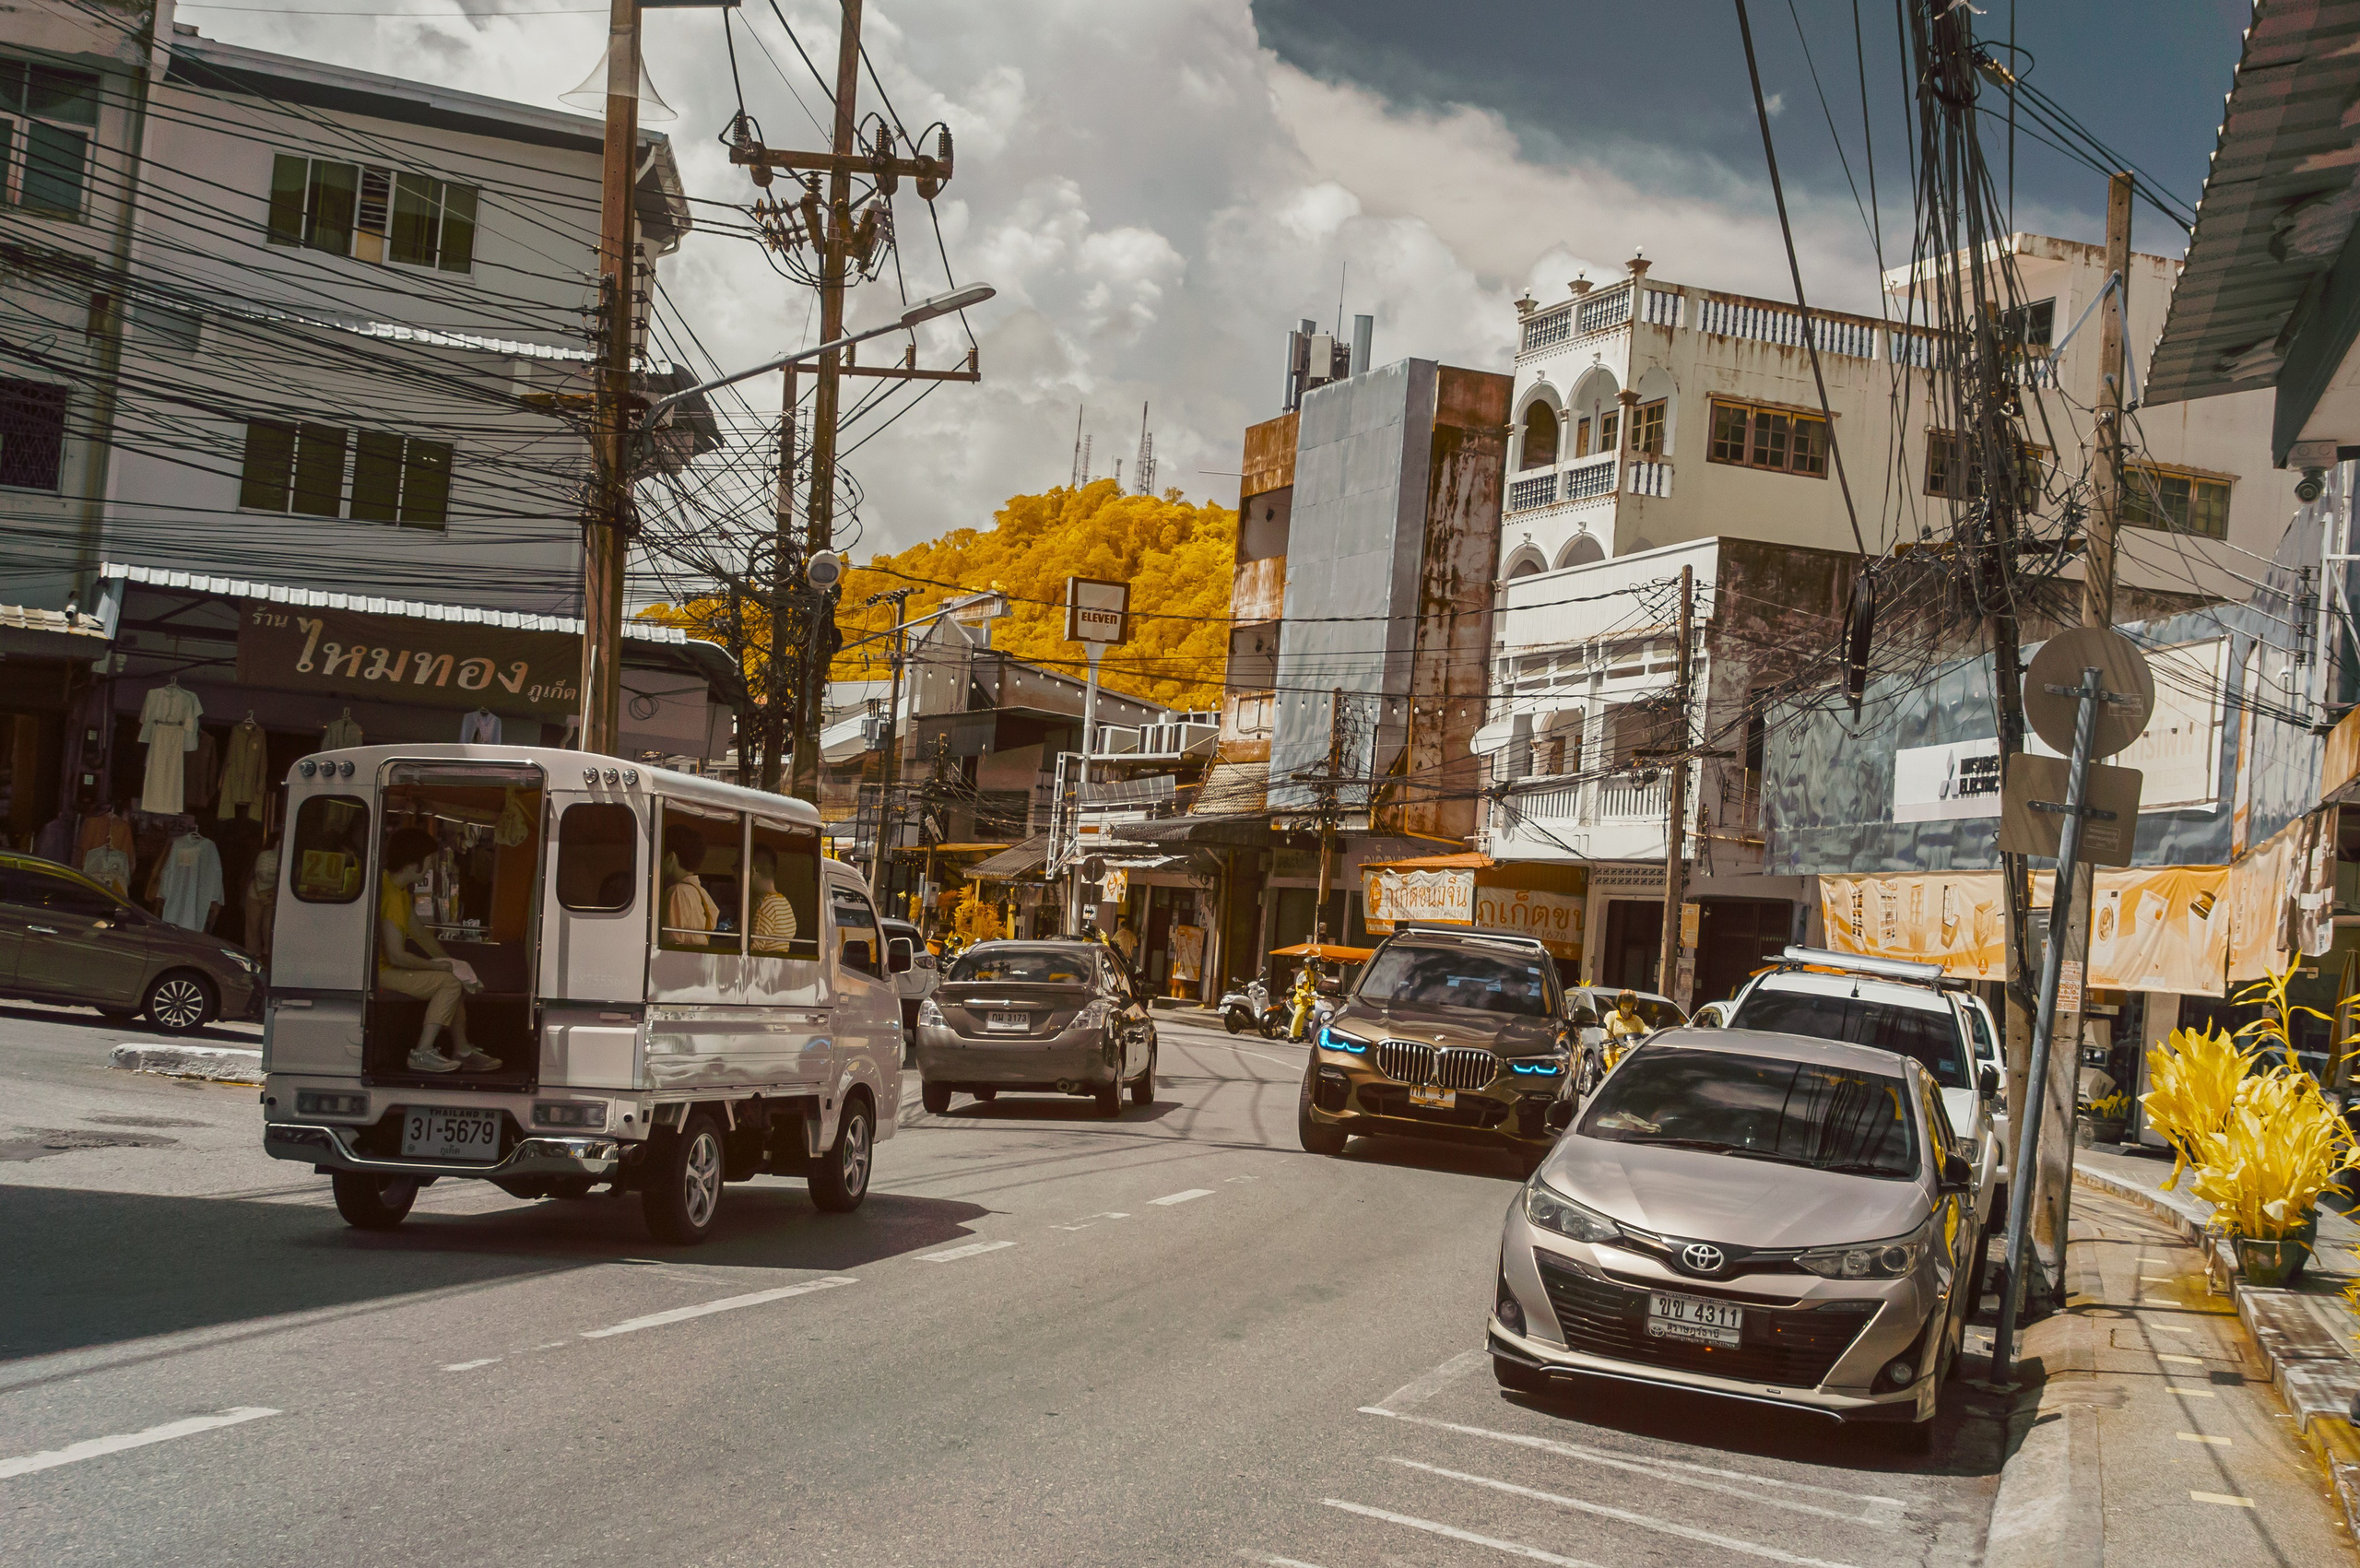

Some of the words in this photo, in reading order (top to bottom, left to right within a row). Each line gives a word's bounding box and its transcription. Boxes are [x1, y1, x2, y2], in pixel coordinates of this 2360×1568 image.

[252, 606, 289, 628] ร้าน
[295, 615, 530, 695] ไหมทอง
[526, 680, 578, 702] ภูเก็ต
[305, 853, 342, 879] 20
[1007, 1013, 1027, 1022] 3173
[1438, 1089, 1446, 1100] 9
[429, 1108, 479, 1117] THAILAND
[410, 1116, 495, 1145] 31-5679
[1694, 1303, 1737, 1326] 4311
